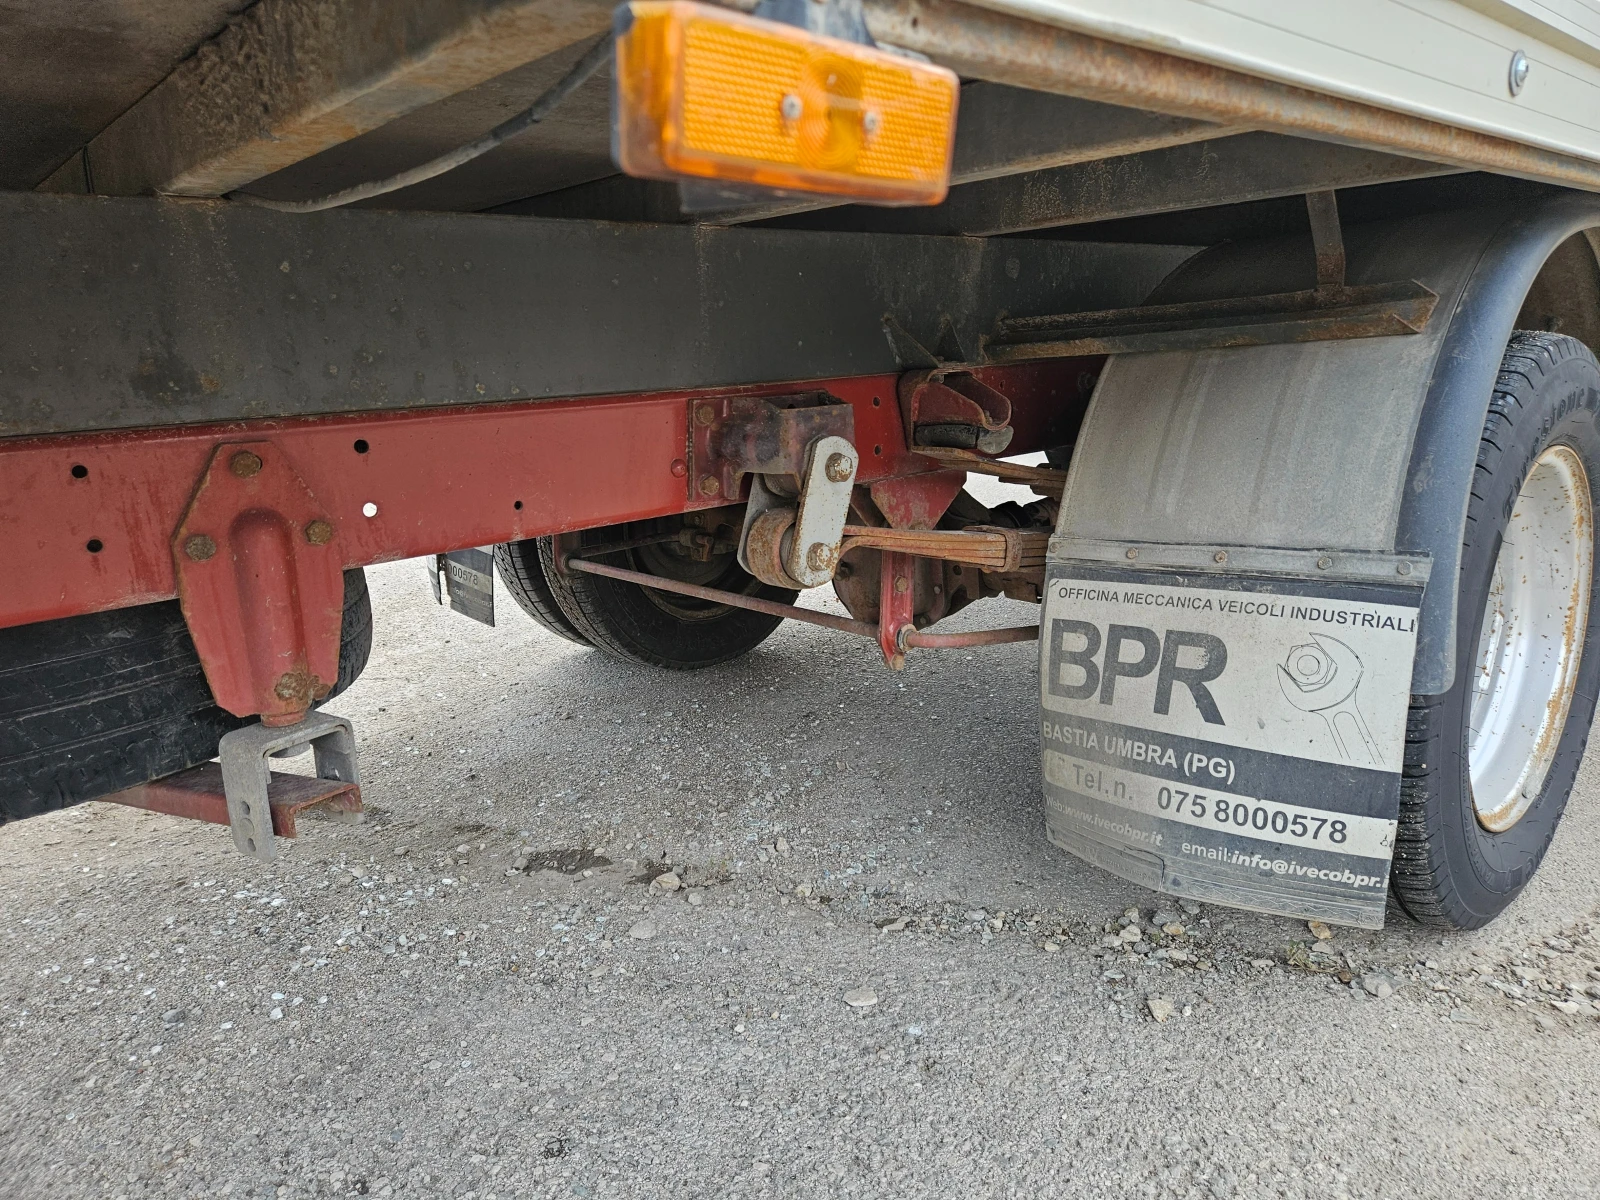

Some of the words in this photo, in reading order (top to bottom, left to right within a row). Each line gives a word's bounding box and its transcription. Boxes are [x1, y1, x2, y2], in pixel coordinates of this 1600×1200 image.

[1058, 587, 1119, 603] OFFICINA
[1123, 592, 1213, 611] MECCANICA
[1218, 600, 1285, 618] VEICOLI
[1290, 606, 1415, 633] INDUSTRIALI
[1048, 618, 1228, 727] BPR
[1043, 721, 1099, 751] BASTIA
[1104, 735, 1177, 769] UMBRA
[1183, 752, 1236, 785] (PG)
[1157, 786, 1207, 818] 075
[1213, 800, 1347, 844] 8000578
